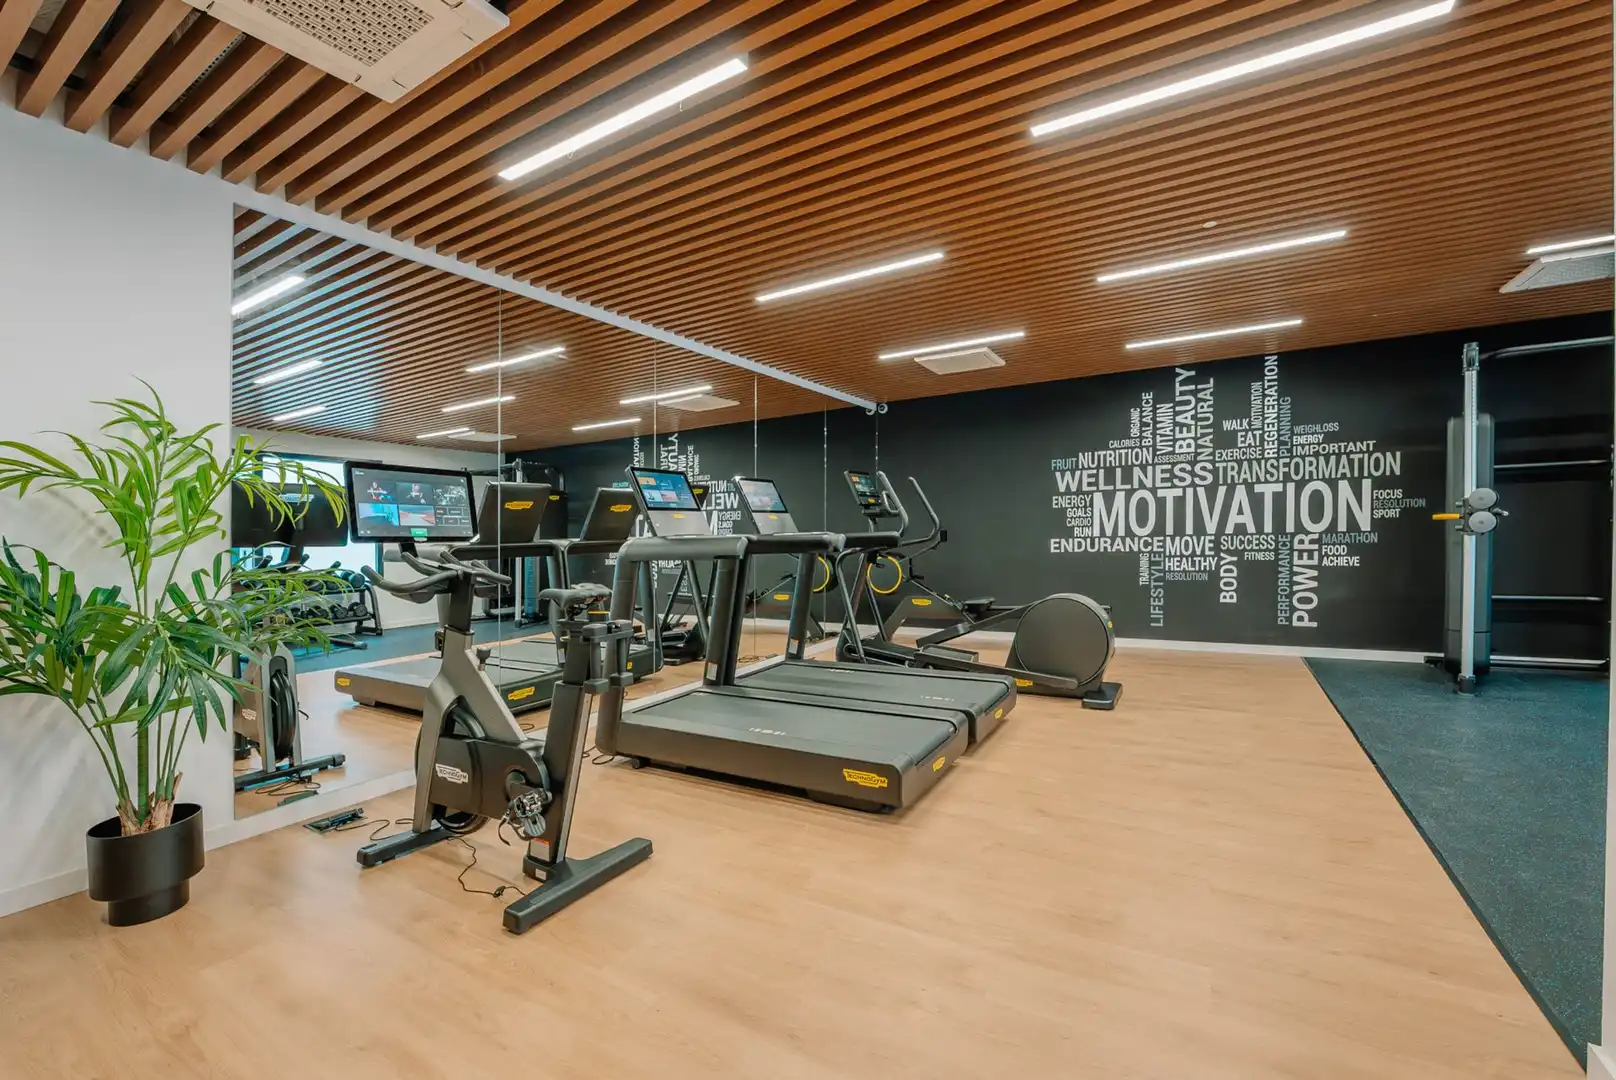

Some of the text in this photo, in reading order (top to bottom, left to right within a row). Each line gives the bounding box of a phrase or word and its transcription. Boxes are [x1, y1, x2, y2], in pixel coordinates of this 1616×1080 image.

[1175, 367, 1196, 453] BEAUTY
[1251, 382, 1262, 429] MOTIVATION
[1264, 355, 1277, 458] REGENERATION
[1131, 408, 1140, 437] ORGANIC
[1142, 392, 1153, 445] BALANCE
[1197, 378, 1213, 460] NATURAL
[1223, 418, 1249, 431] WALK
[1156, 403, 1173, 454] VITAMIN
[1280, 396, 1291, 456] PLANNING
[1294, 422, 1339, 433] WEIGHLOSS
[1109, 438, 1140, 448] CALORIES
[1238, 431, 1262, 447] EAT
[1293, 434, 1324, 444] ENERGY
[1216, 447, 1262, 461] EXERCISE
[1293, 441, 1376, 456] IMPORTANT
[1052, 458, 1076, 469] FRUIT
[1079, 448, 1152, 468] NUTRITION
[1154, 454, 1194, 463] ASSESSMENT
[1216, 452, 1401, 484] TRANSFORMATION
[1055, 463, 1213, 492] WELLNESS
[1053, 495, 1091, 508] ENERGY
[1373, 490, 1403, 499] FOCUS
[1094, 479, 1372, 537] MOTIVATION
[1373, 498, 1425, 508] RESOLUTION
[1067, 508, 1091, 517] GOALS
[1373, 509, 1400, 519] SPORT
[1067, 518, 1091, 527] CARDIO
[1074, 527, 1091, 537] RUN
[1322, 533, 1378, 543] MARATHON
[1051, 536, 1164, 553] ENDURANCE
[1166, 536, 1214, 555] MOVE
[1221, 535, 1275, 549] SUCCESS
[1245, 552, 1274, 561] FITNESS
[1322, 545, 1347, 555] FOOD
[1165, 557, 1217, 571] HEALTHY
[1322, 557, 1360, 566] ACHIEVE
[1140, 553, 1149, 586] TRAINING
[1166, 573, 1208, 581] RESOLUTION
[1220, 553, 1238, 603] BODY
[1278, 535, 1290, 625] PERFORMANCE
[1293, 533, 1319, 627] POWER
[1150, 553, 1164, 627] LIFESTYLE
